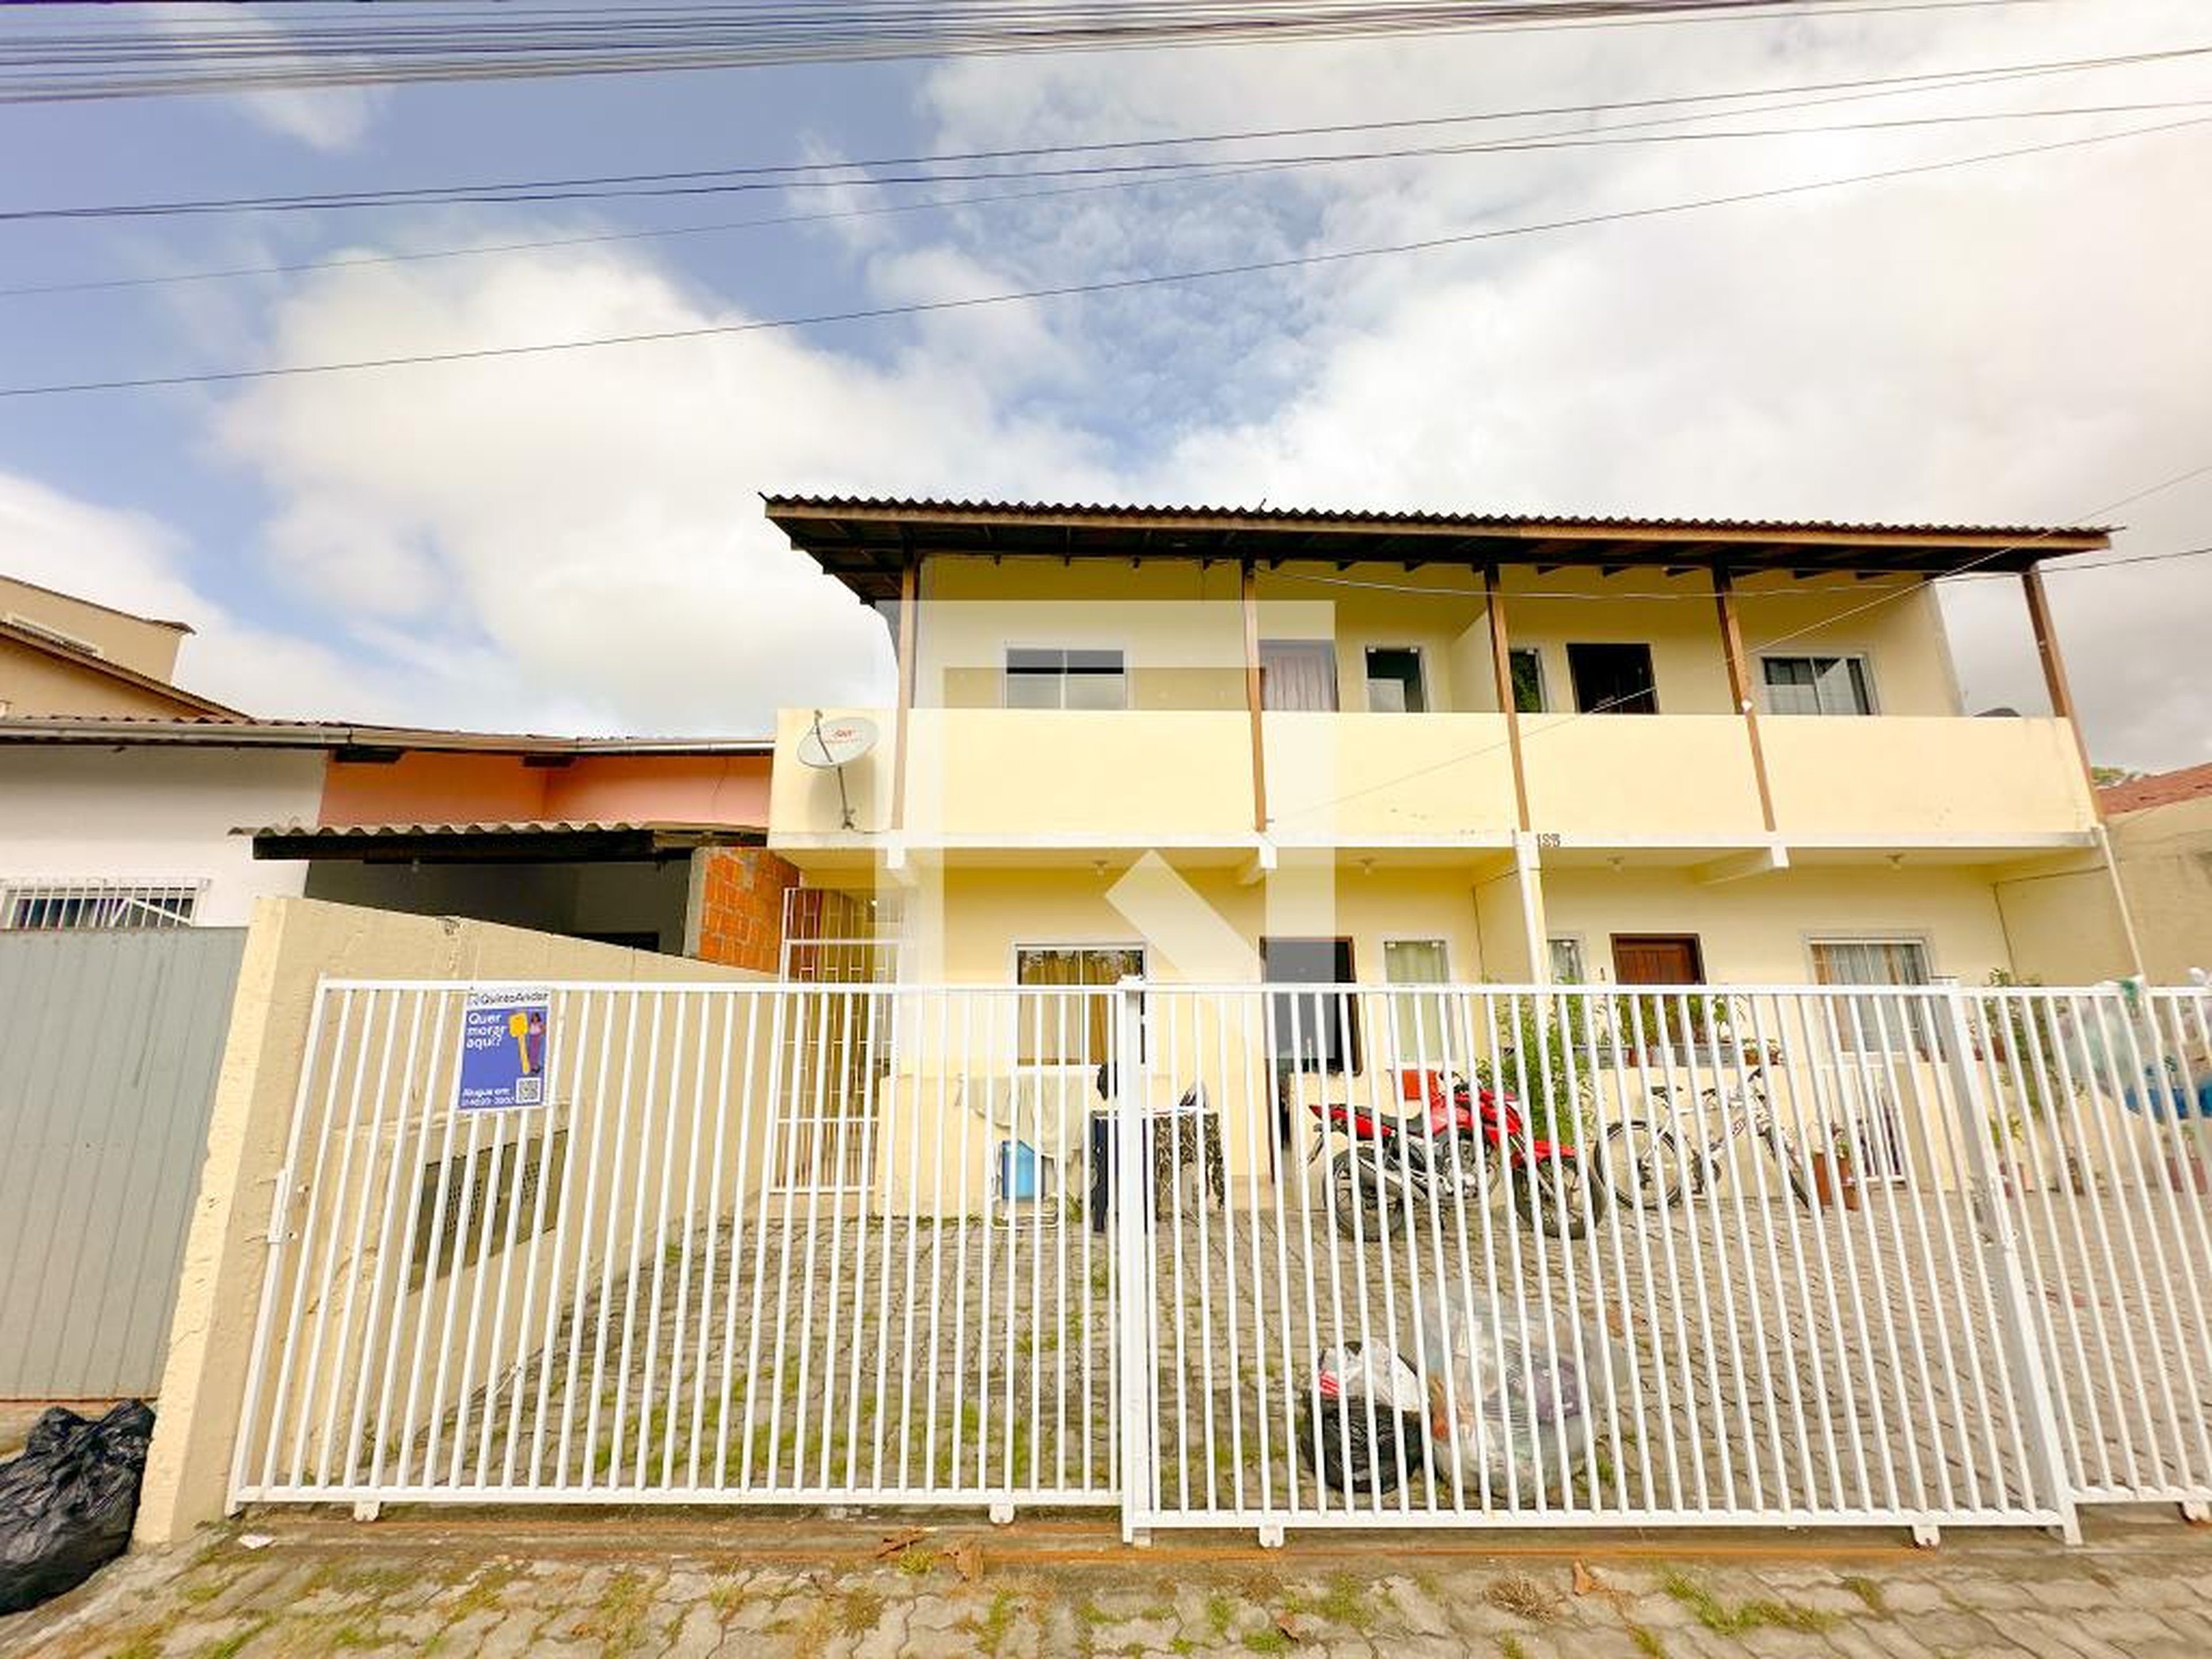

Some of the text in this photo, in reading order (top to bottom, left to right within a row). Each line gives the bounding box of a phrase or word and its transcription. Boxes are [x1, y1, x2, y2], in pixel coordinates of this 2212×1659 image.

[468, 1013, 502, 1025] Quer
[467, 1025, 507, 1036] morar
[466, 1037, 502, 1050] aqui?
